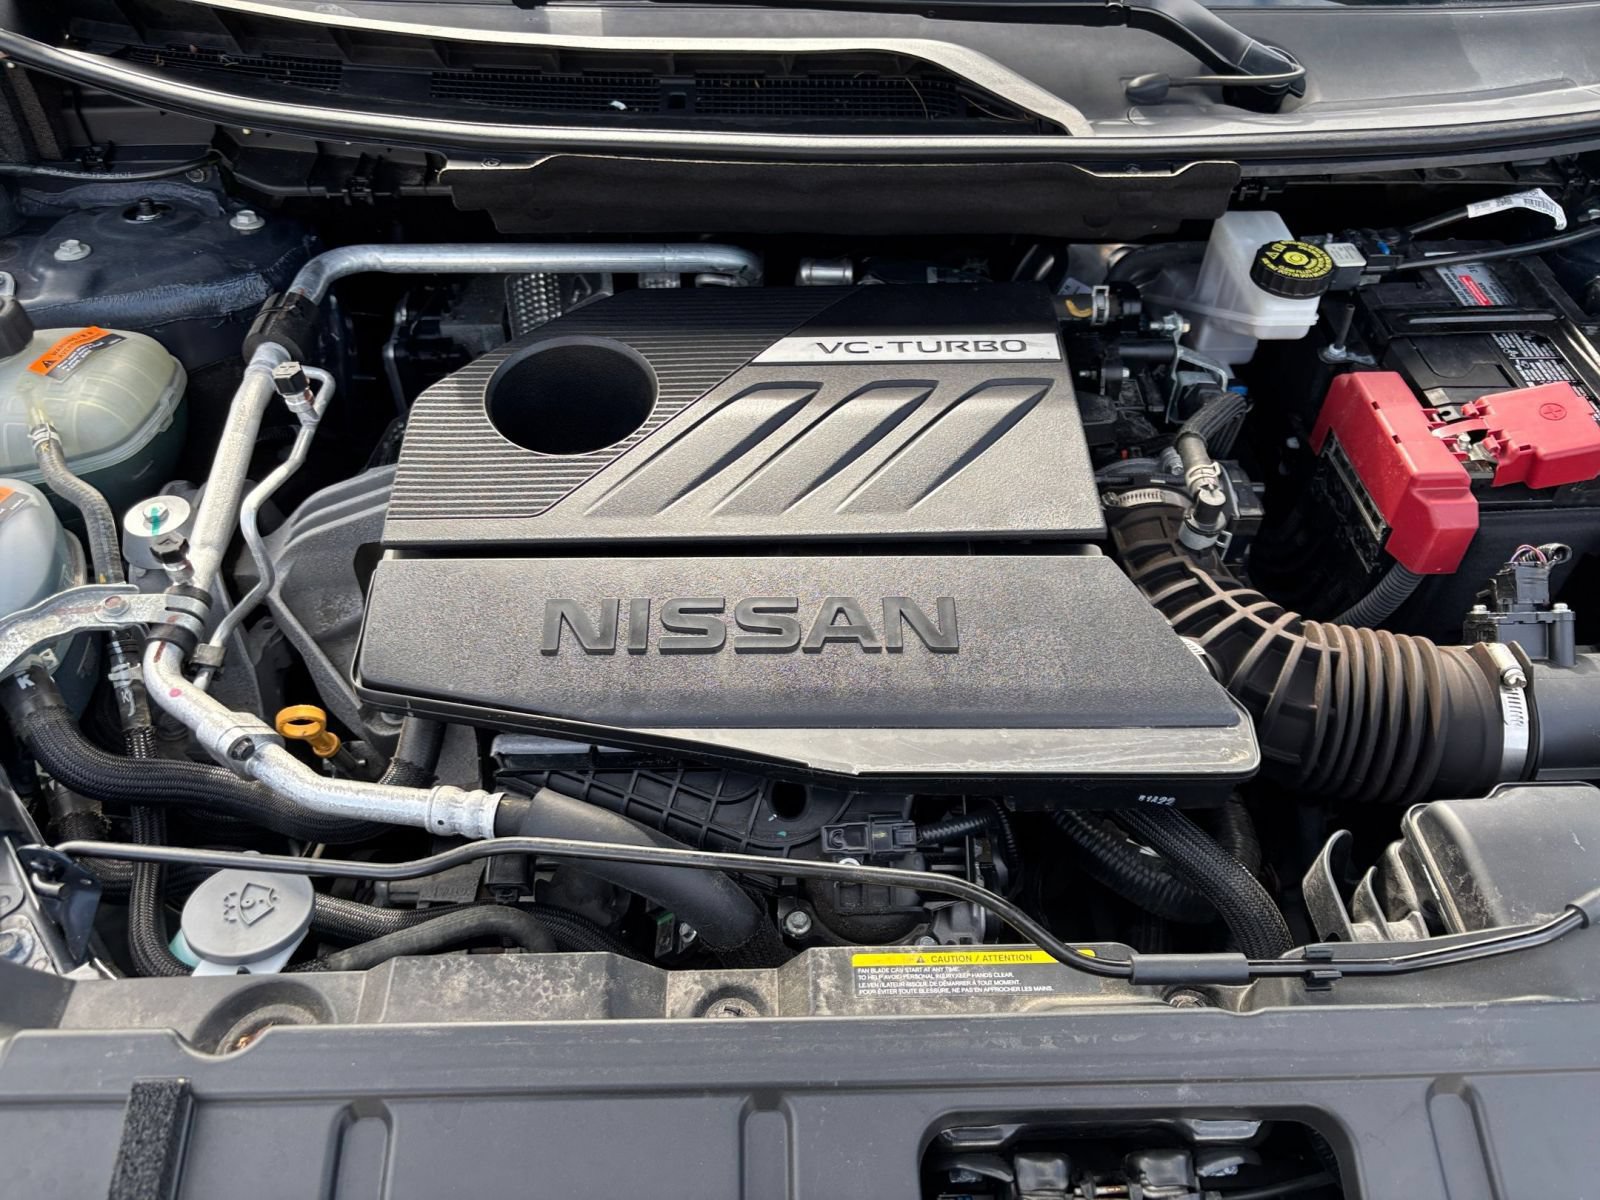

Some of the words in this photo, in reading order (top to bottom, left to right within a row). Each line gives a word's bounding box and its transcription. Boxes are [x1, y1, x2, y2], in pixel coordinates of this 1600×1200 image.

[816, 339, 1027, 354] VC-TURBO
[541, 596, 959, 656] NISSAN
[930, 955, 972, 963] CAUTION
[982, 954, 1033, 962] ATTENTION
[877, 987, 898, 995] ÉVITER
